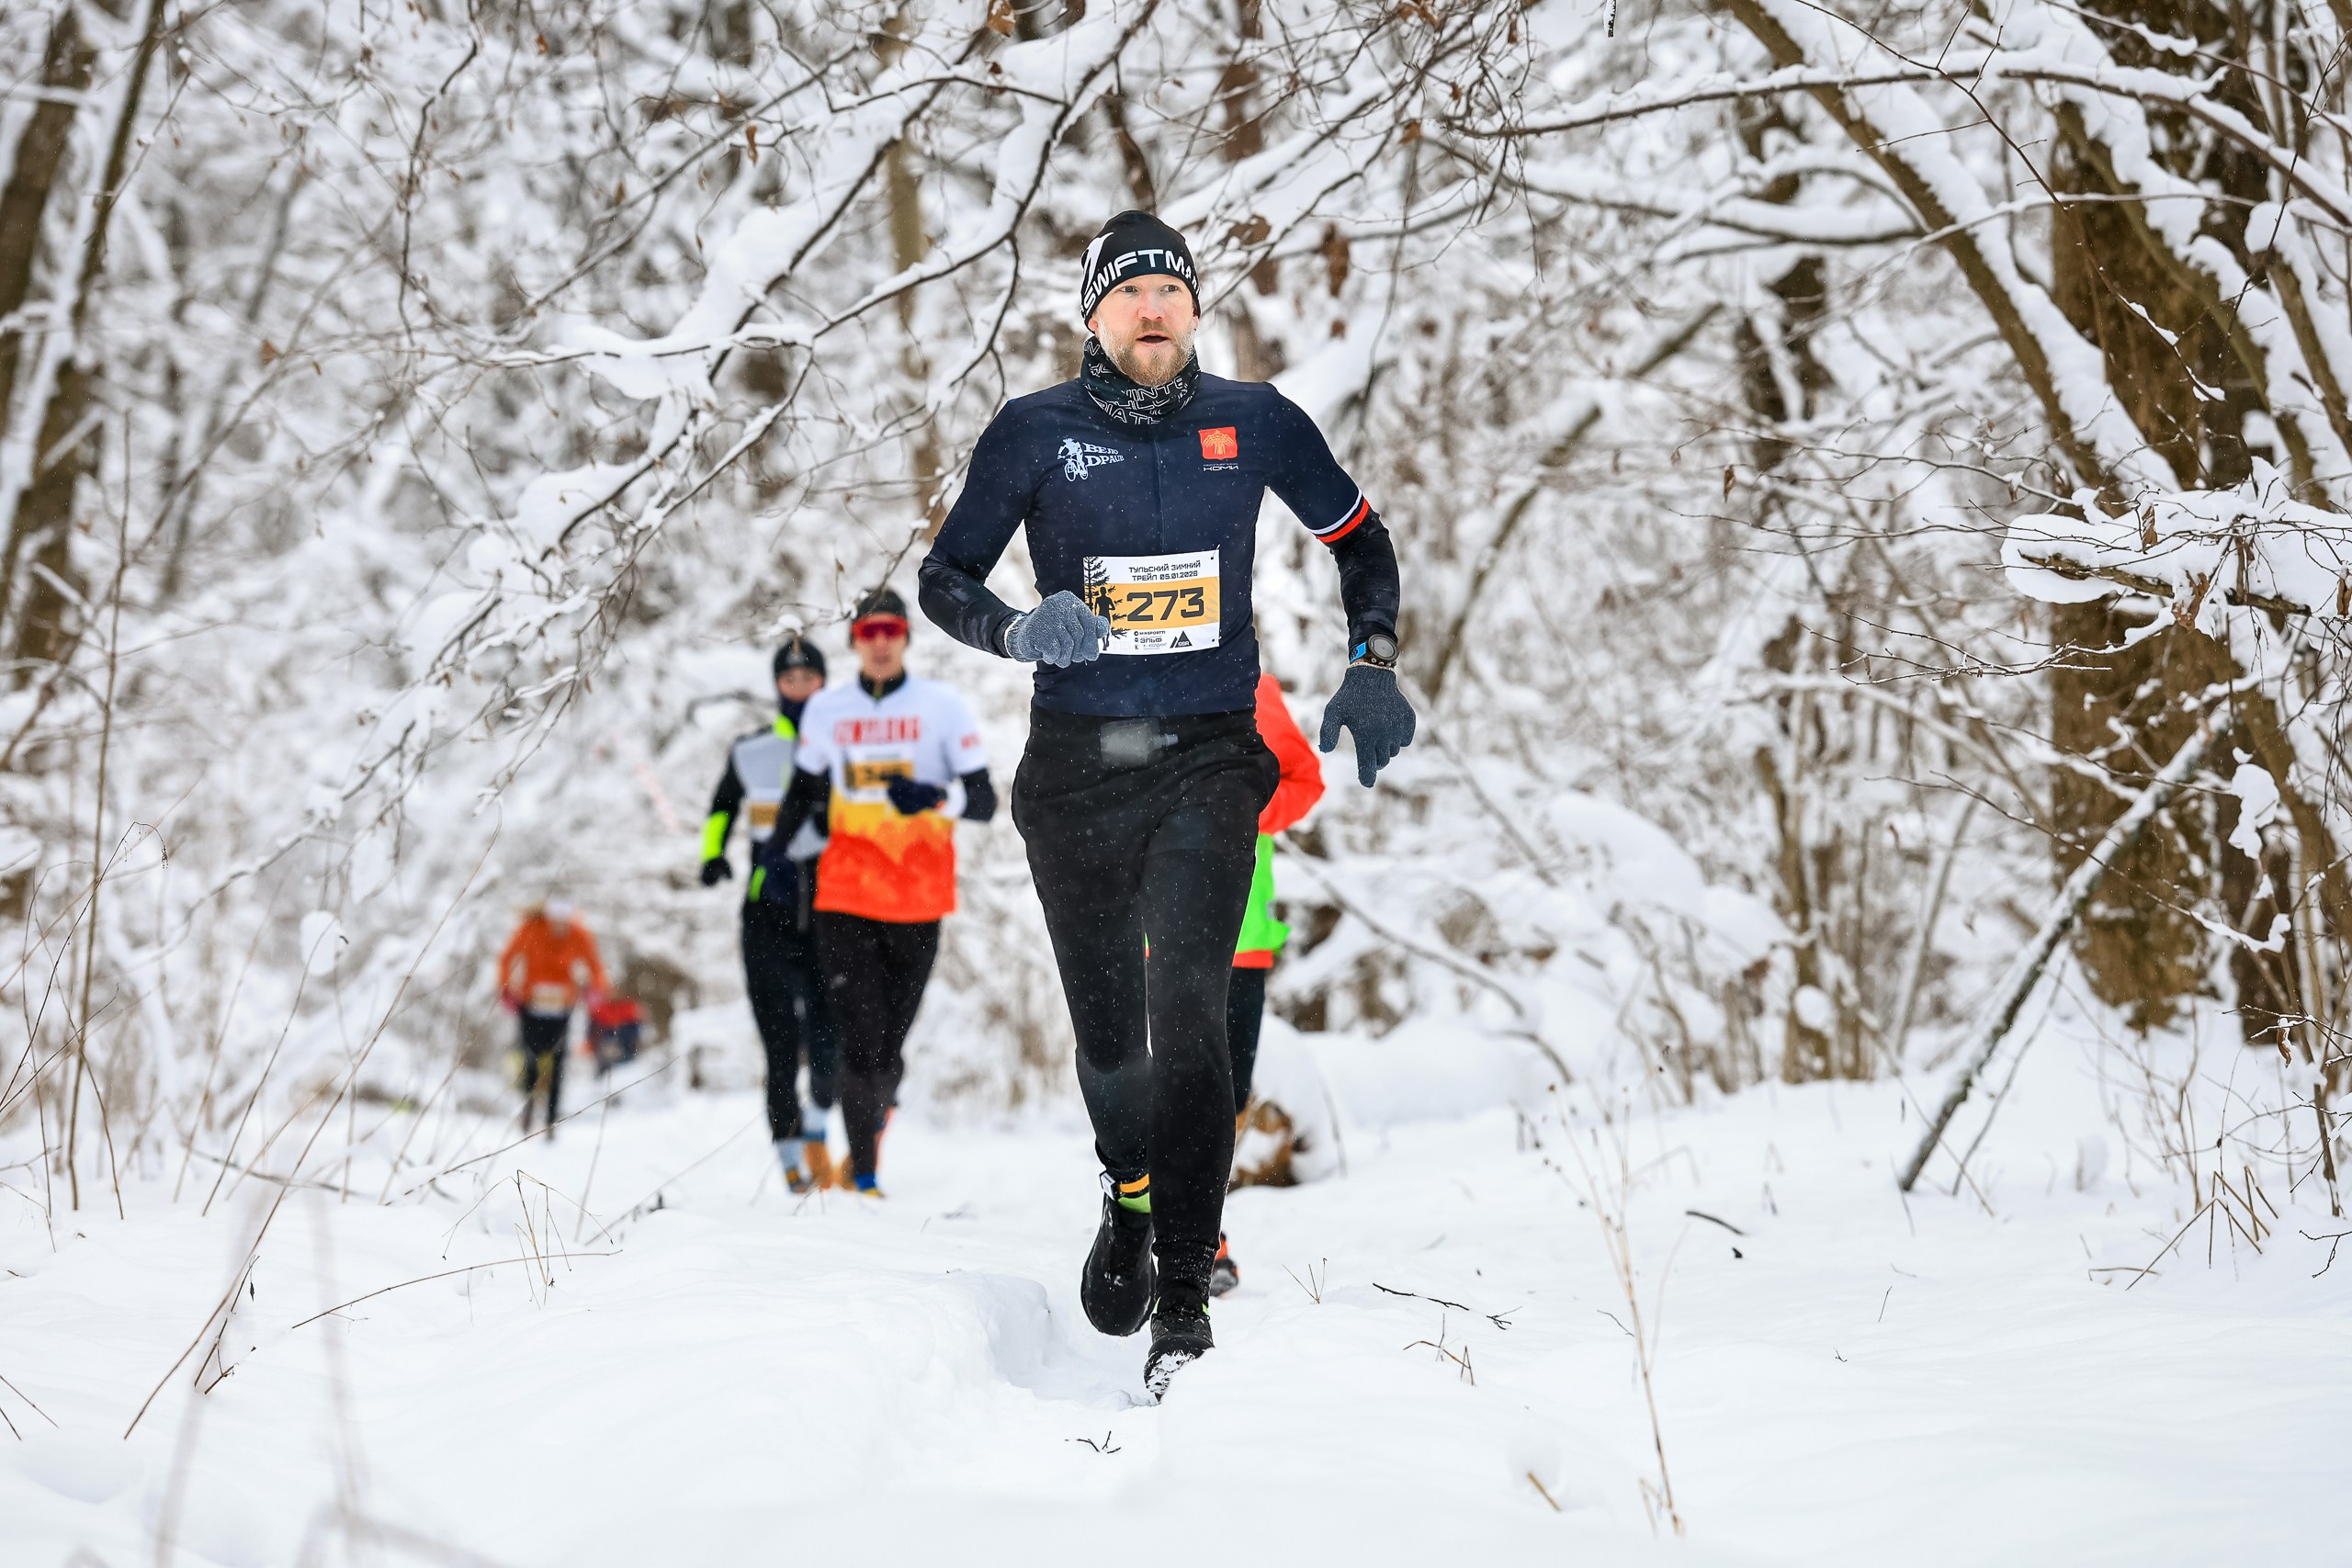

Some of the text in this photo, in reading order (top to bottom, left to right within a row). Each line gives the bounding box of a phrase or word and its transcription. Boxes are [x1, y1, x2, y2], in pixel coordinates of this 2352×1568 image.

[1128, 559, 1201, 573] ТУЛЬСКИЙ ЗИМНИЙ
[1132, 573, 1158, 581] ТРЕЙЛ
[1126, 586, 1204, 622] 273
